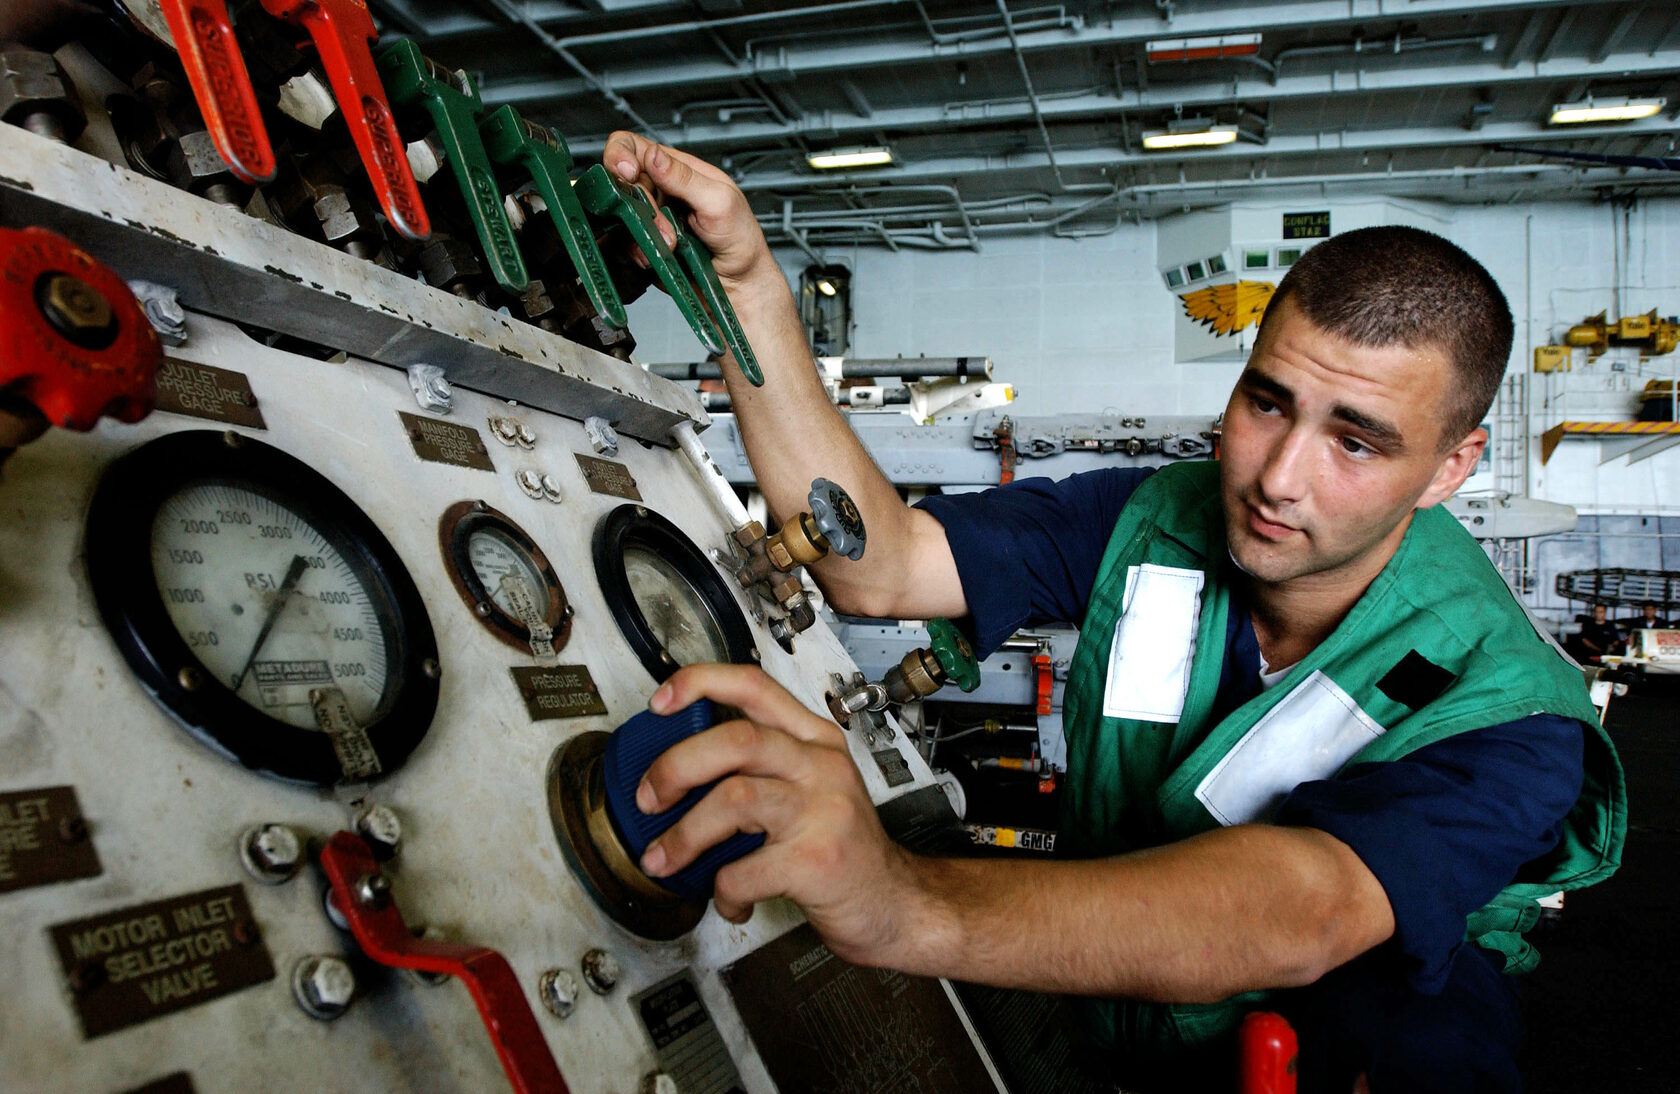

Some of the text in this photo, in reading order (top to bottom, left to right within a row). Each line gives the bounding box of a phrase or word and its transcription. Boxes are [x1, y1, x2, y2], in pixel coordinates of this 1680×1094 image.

[179, 394, 225, 415] GAGE
[418, 420, 467, 441] MANIFOLD
[423, 433, 475, 454] PRESSURE
[440, 447, 470, 463] GAGE
[217, 510, 252, 525] 2500
[181, 520, 219, 535] 2000
[258, 525, 292, 539] 3000
[168, 549, 204, 564] 1500
[302, 555, 326, 569] 500
[167, 588, 205, 603] 1000
[320, 591, 351, 604] 4000
[190, 631, 219, 646] 500
[333, 628, 363, 641] 4500
[334, 663, 366, 678] 5000
[530, 673, 582, 690] PRESSURE
[536, 692, 594, 709] REGULATOR
[69, 895, 237, 959] MOTOR INLET
[105, 930, 233, 983] SELECTOR
[141, 963, 219, 1006] VALVE
